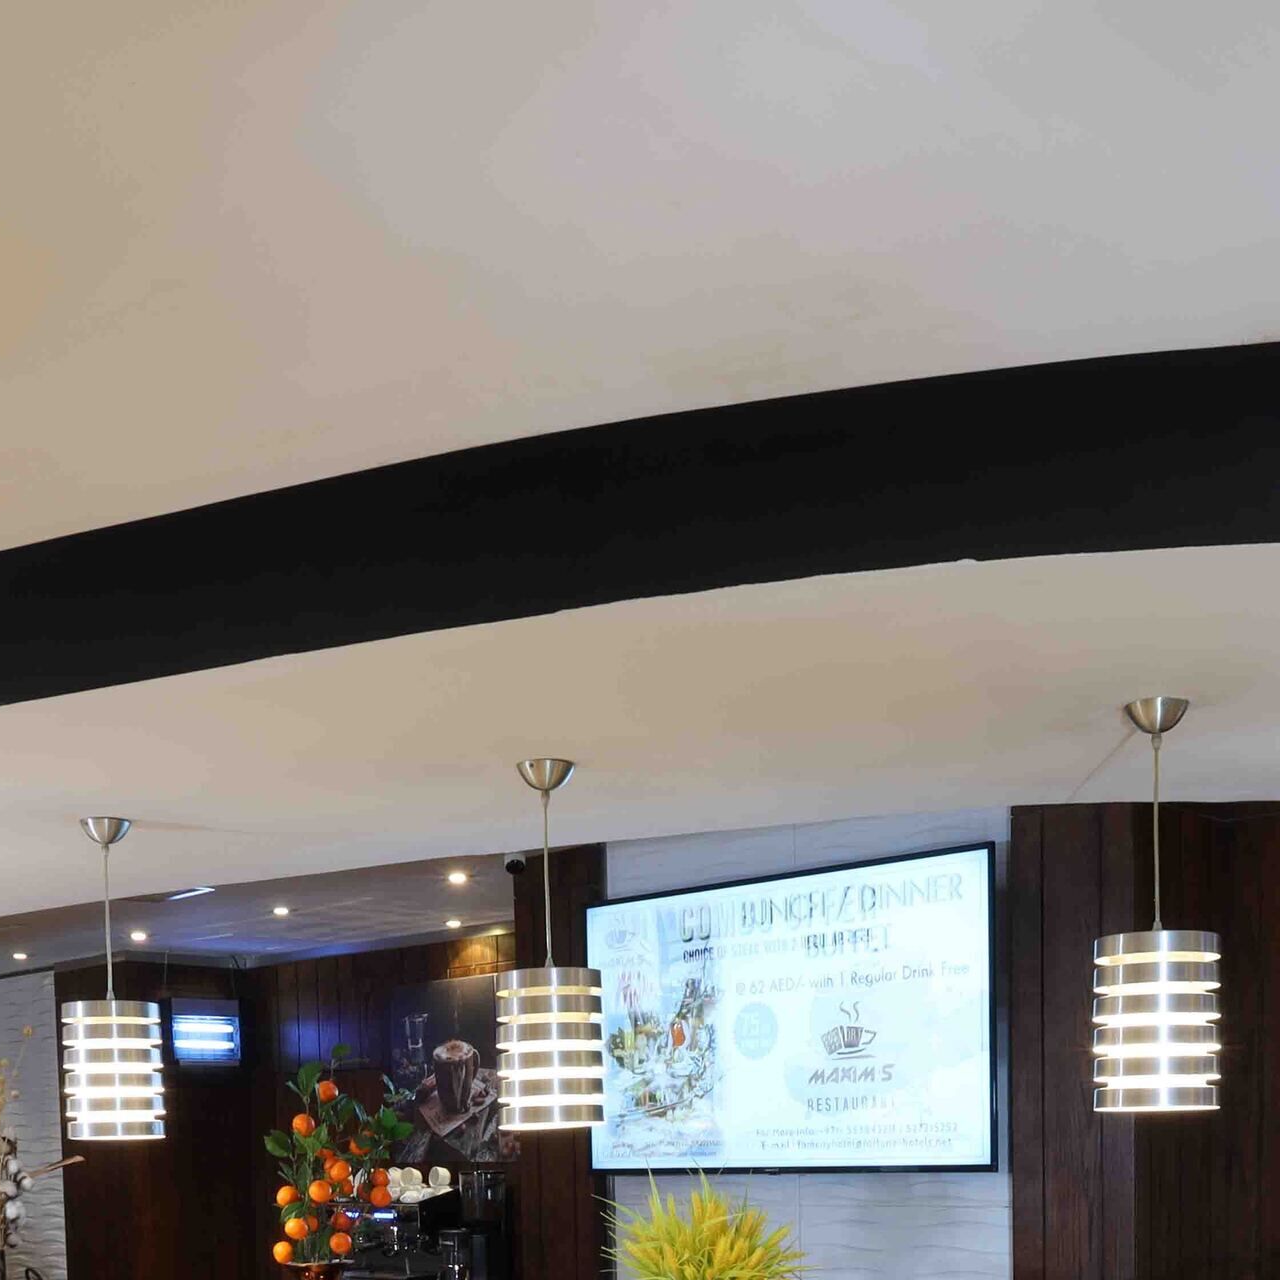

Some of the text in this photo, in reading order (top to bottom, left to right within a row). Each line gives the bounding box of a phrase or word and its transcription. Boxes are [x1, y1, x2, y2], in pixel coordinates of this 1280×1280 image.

[683, 946, 714, 964] CHOICE
[808, 974, 834, 990] with
[850, 968, 897, 988] Regular
[902, 963, 934, 980] Drink
